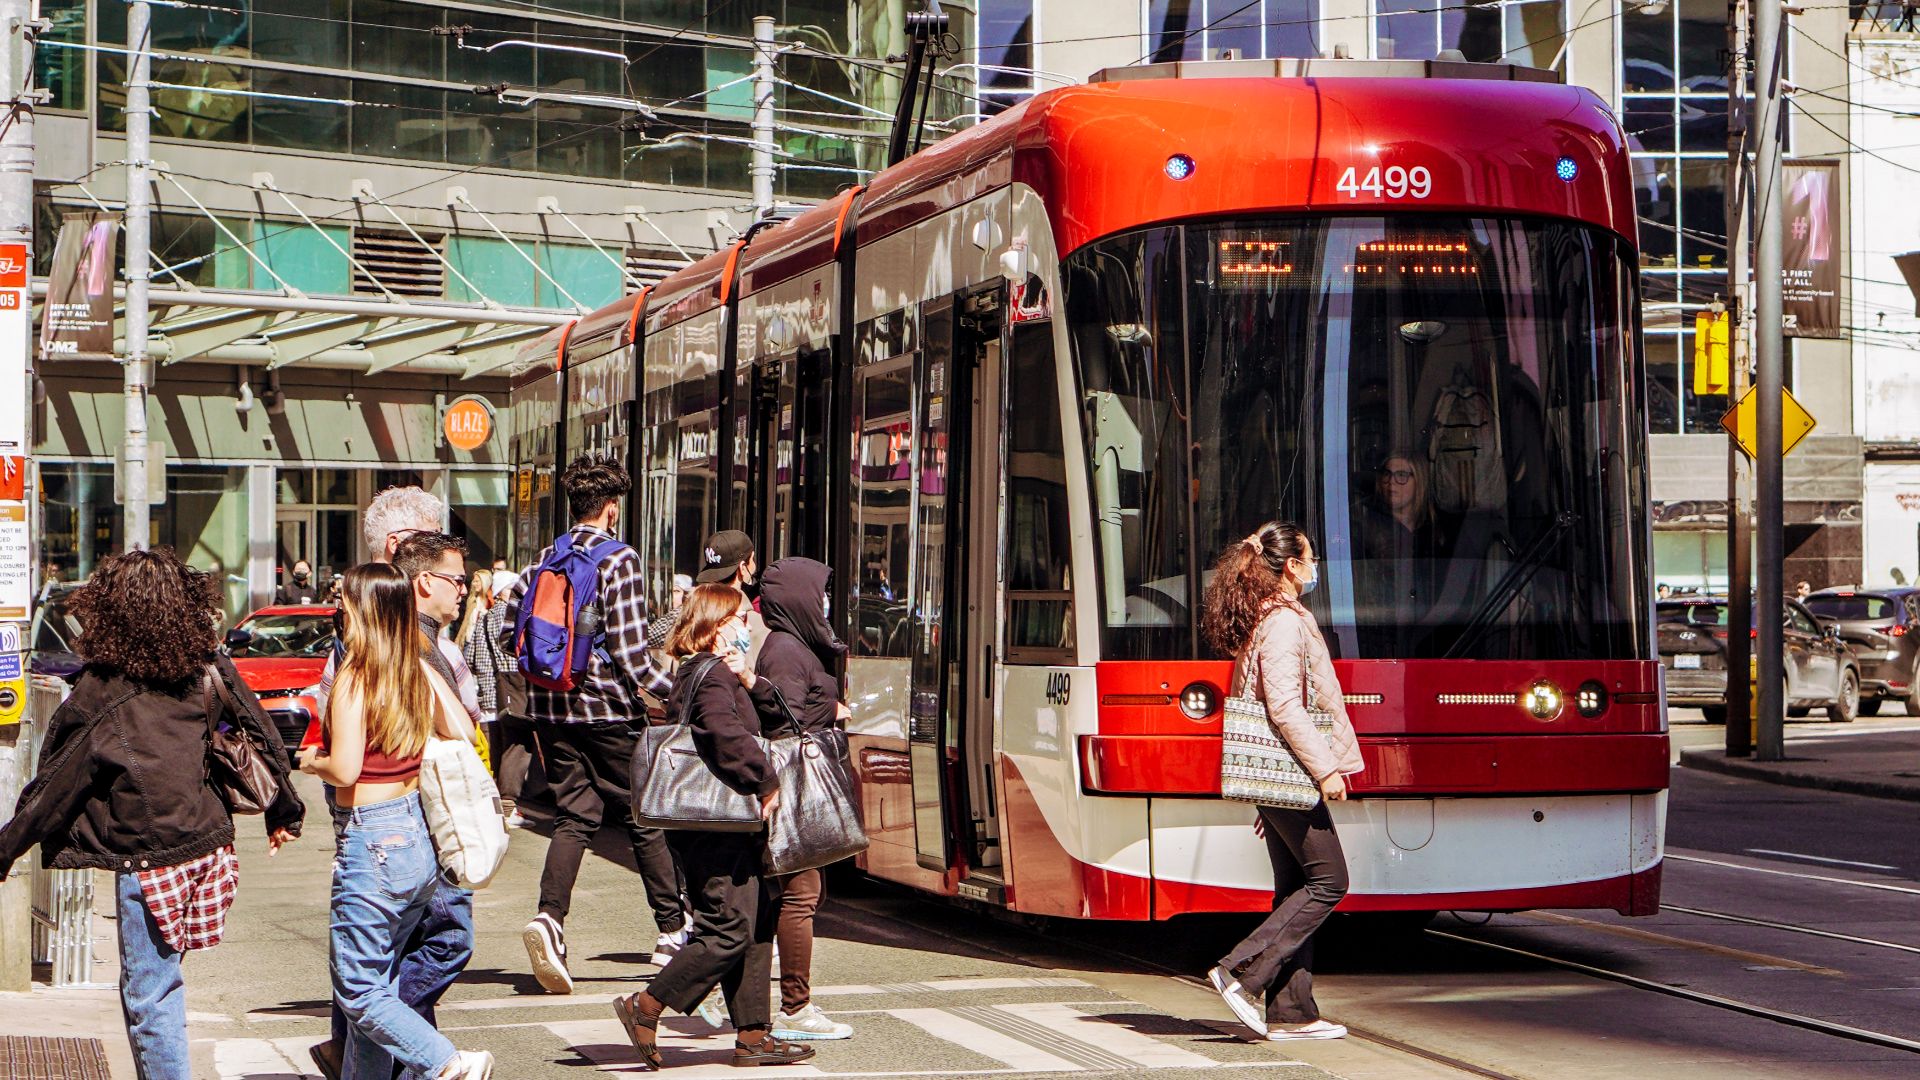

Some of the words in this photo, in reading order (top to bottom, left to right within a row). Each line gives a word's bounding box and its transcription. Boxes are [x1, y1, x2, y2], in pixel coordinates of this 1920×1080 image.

[1336, 165, 1432, 198] 4499
[46, 341, 78, 353] DMZ
[451, 410, 483, 432] BLAZE
